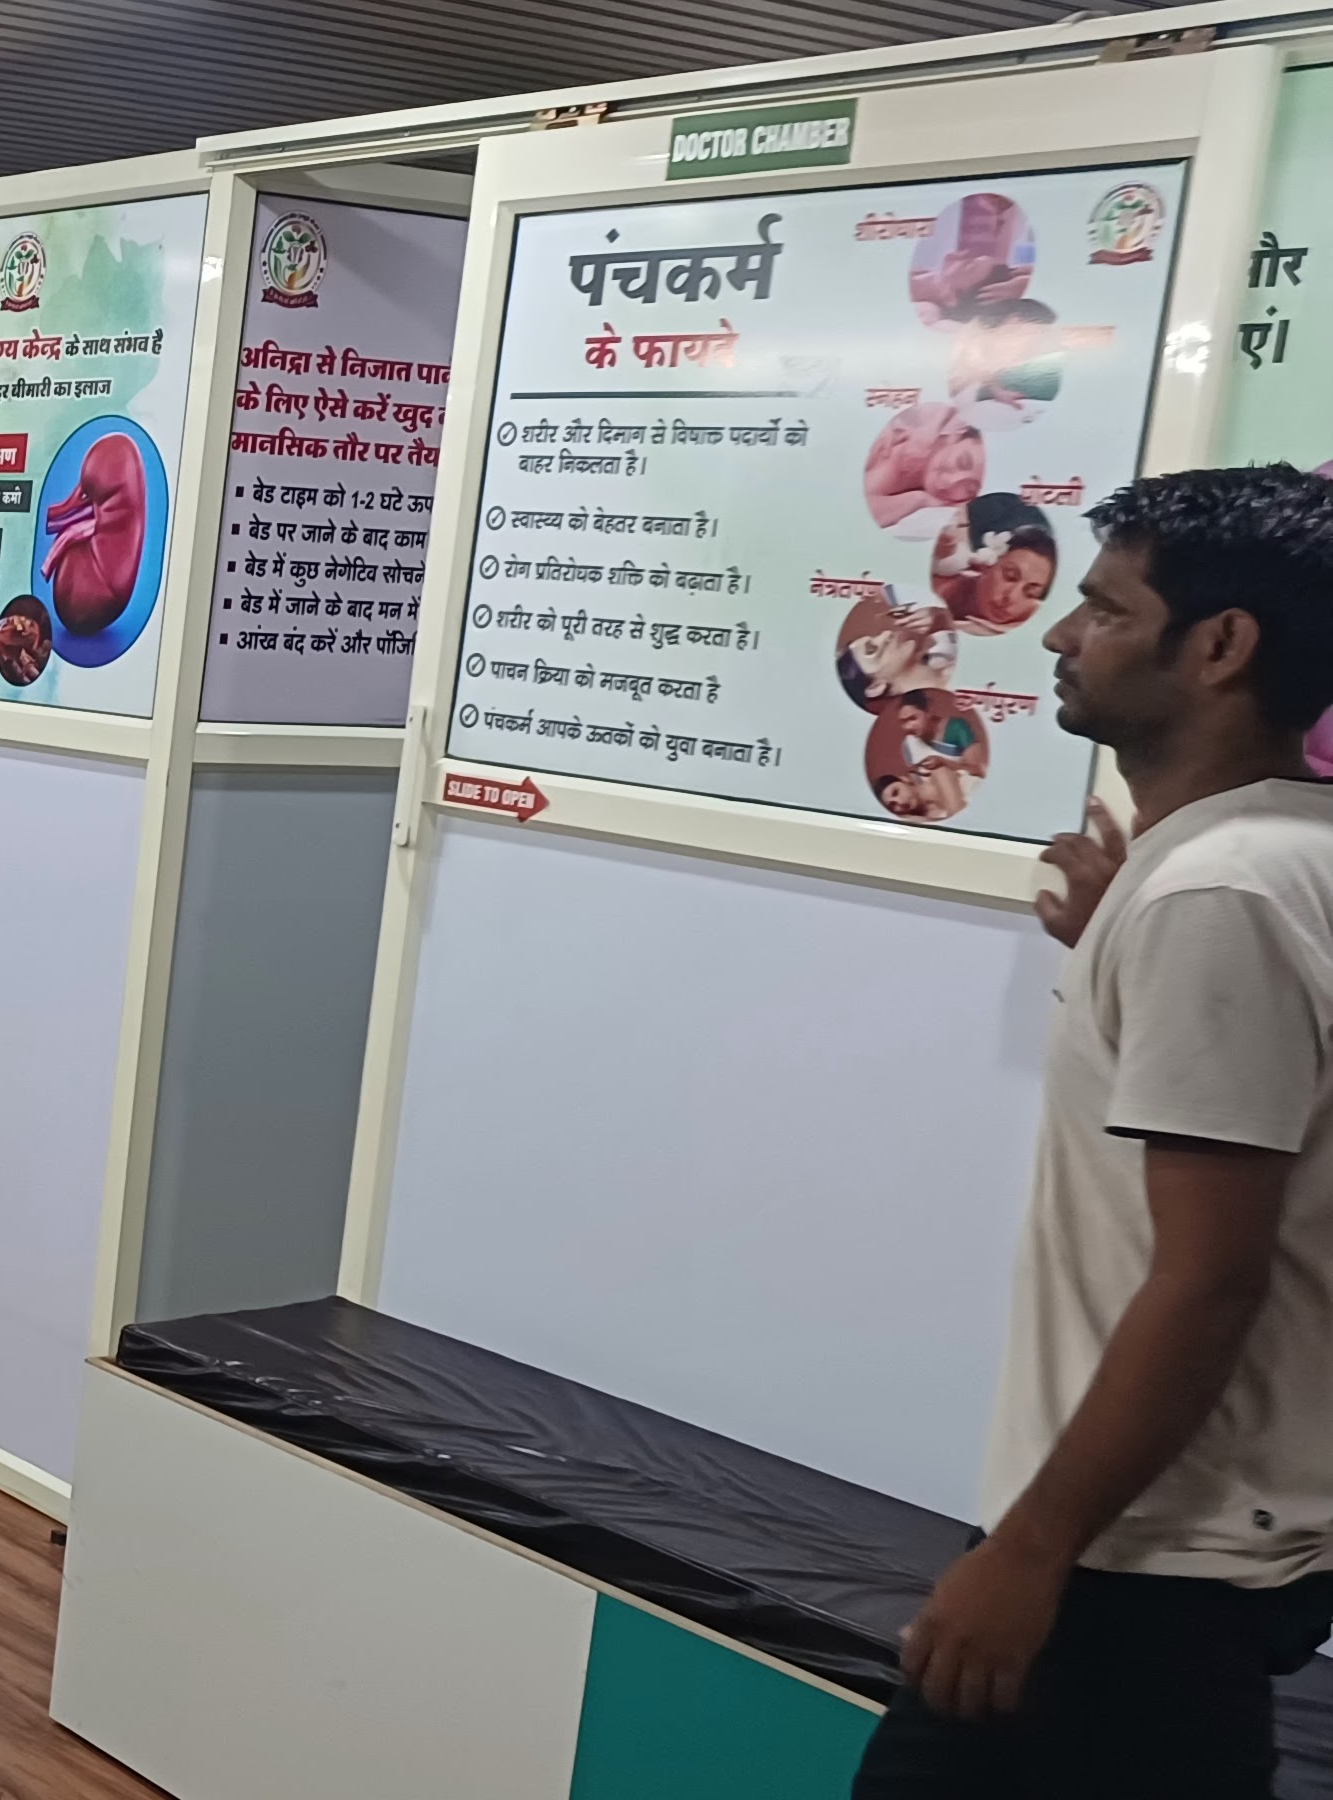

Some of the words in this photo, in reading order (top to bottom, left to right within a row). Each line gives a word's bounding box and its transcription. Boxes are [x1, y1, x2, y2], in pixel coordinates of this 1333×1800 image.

[671, 127, 747, 163] DOCTOR
[751, 117, 851, 155] CHAMBER
[569, 213, 784, 306] पंचकर्म
[22, 329, 62, 361] केन्द्र
[65, 334, 79, 356] के
[82, 335, 112, 356] साथ
[114, 332, 150, 354] संभव
[152, 329, 163, 355] है
[241, 340, 311, 375] अनिद्रा
[317, 345, 335, 375] से
[341, 348, 413, 382] निजात
[585, 322, 622, 369] के
[54, 382, 72, 397] का
[74, 380, 112, 398] इलाज
[231, 427, 329, 459] मानसिक
[333, 432, 369, 462] तौर
[375, 444, 403, 464] पर
[521, 419, 557, 444] शरीर
[563, 418, 593, 444] और
[651, 419, 666, 445] से
[784, 419, 809, 446] को
[2, 486, 22, 504] कमी
[253, 476, 275, 503] बेड
[281, 486, 319, 509] टाइम
[323, 482, 346, 508] को
[352, 490, 375, 510] 1-2
[380, 486, 404, 512] घंटे
[249, 513, 272, 540] बेड
[277, 522, 297, 542] पर
[302, 518, 335, 544] जाने
[341, 520, 359, 544] के
[363, 528, 390, 550] बाद
[394, 530, 428, 549] काम
[496, 605, 532, 629] शरीर
[537, 608, 557, 631] को
[561, 610, 587, 641] पूरी
[592, 617, 623, 638] तरह
[630, 614, 645, 640] से
[686, 626, 733, 648] करता
[447, 780, 481, 799] SLIDE
[484, 785, 498, 802] TO
[502, 787, 535, 809] OPEN
